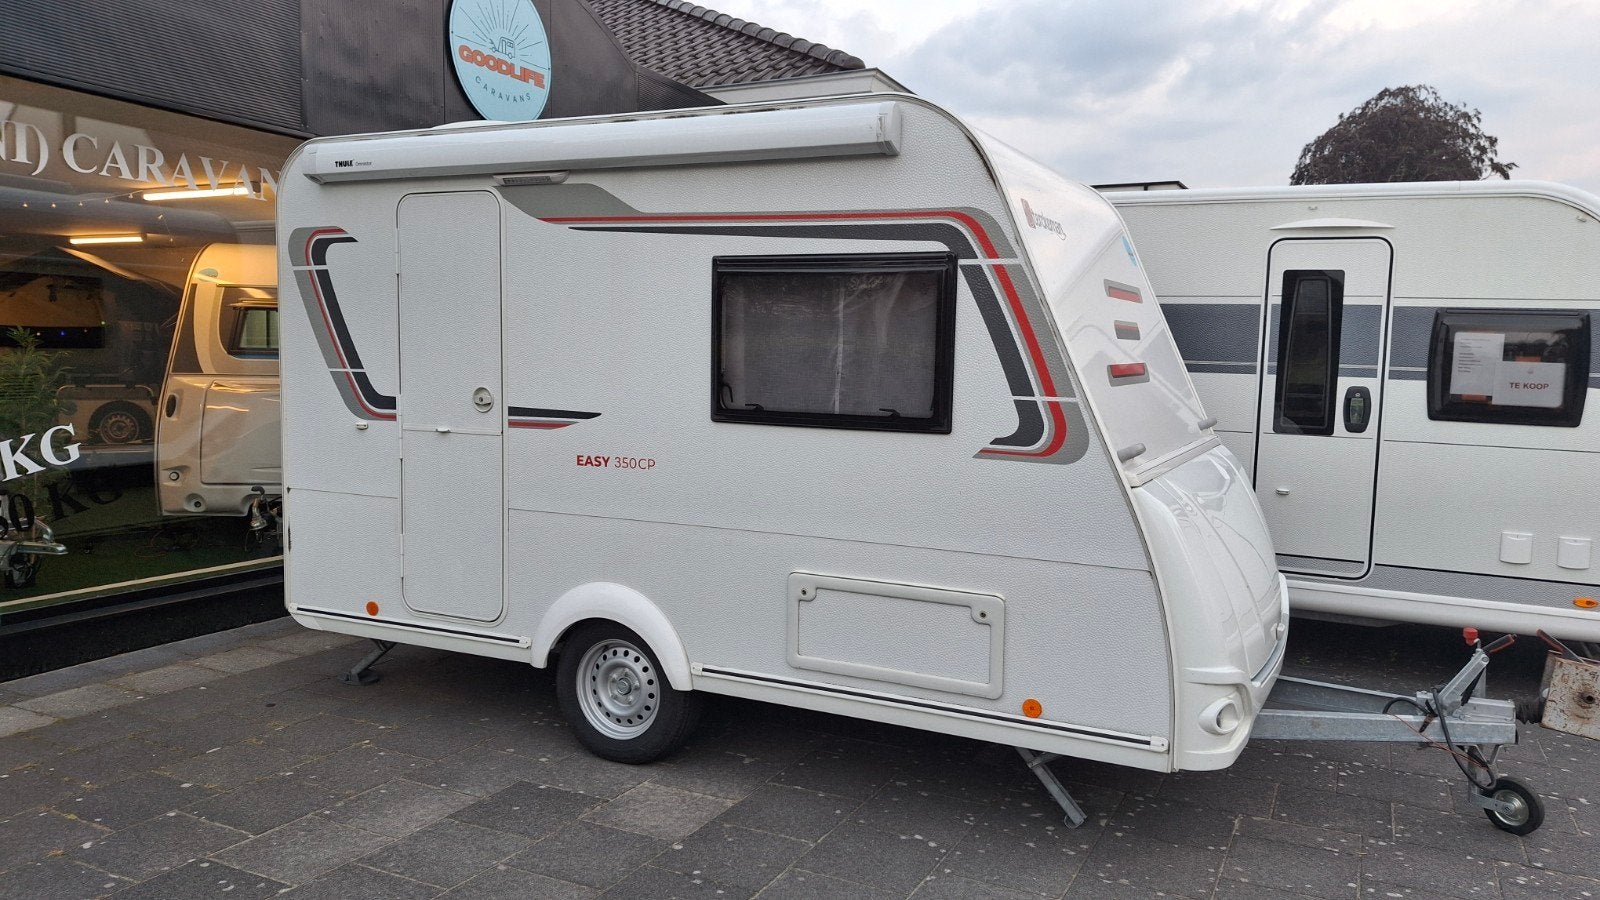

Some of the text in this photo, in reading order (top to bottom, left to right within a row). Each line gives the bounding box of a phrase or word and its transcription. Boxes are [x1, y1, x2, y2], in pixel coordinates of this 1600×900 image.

[458, 44, 546, 90] GOODLIFE
[475, 75, 532, 104] CARAVANS
[334, 159, 354, 168] THULE
[1509, 382, 1550, 390] TE KOOP
[0, 422, 82, 482] KG
[576, 454, 656, 470] EASY 350CP
